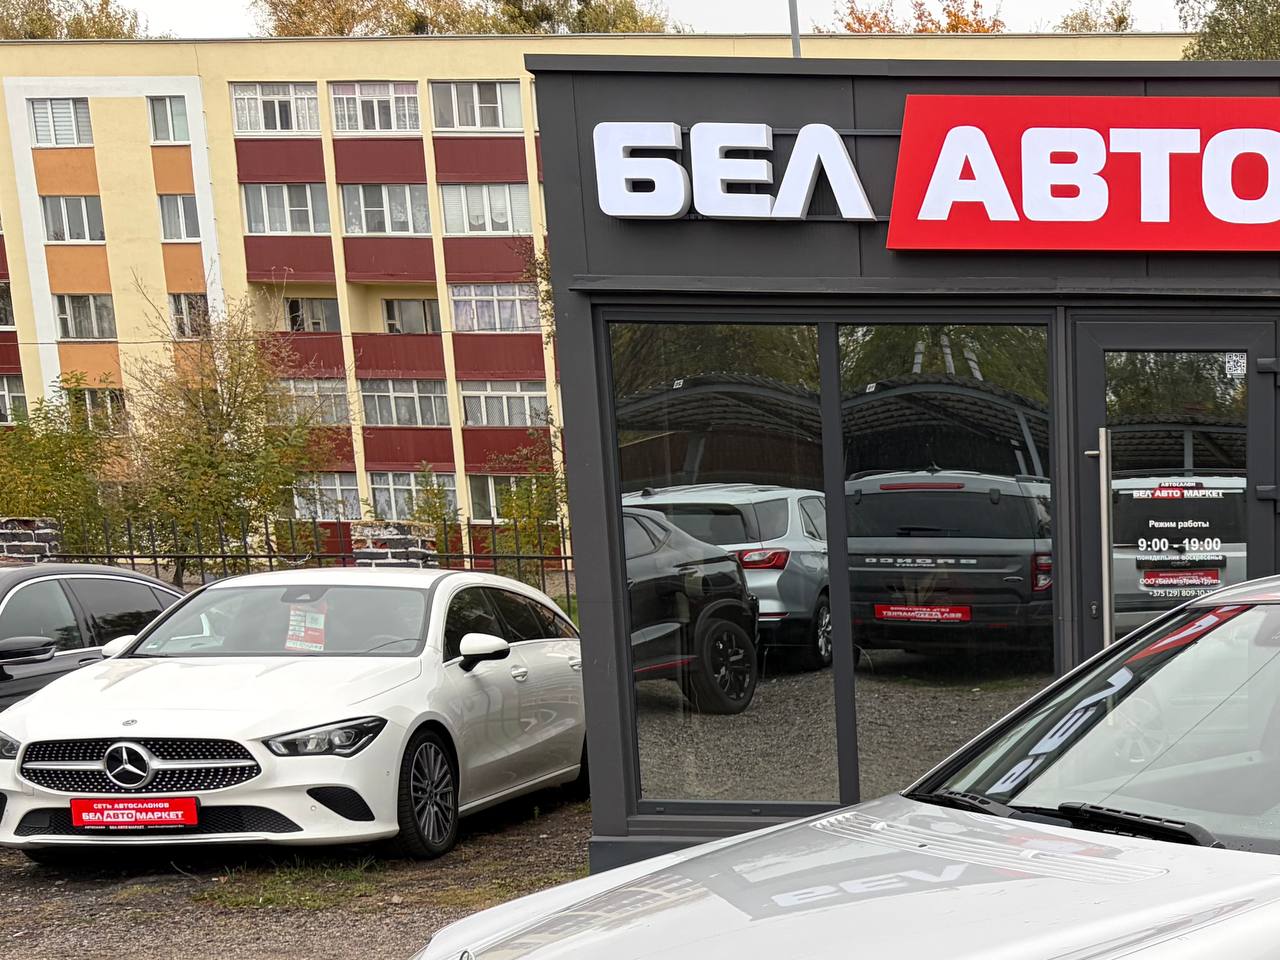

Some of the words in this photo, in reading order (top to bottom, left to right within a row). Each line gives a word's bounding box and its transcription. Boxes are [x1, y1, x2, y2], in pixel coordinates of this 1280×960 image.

[593, 122, 877, 221] БЕЛ
[1133, 490, 1152, 498] БЕЛ
[1154, 490, 1181, 498] АВТО
[1183, 490, 1224, 498] МАРКЕТ
[1149, 520, 1176, 528] Режим
[1178, 520, 1210, 530] работы
[1138, 538, 1169, 551] 9:00
[1183, 538, 1221, 551] 19:00
[82, 812, 103, 820] БЕЛ
[105, 812, 134, 820] АВТО
[136, 811, 184, 820] МАРКЕТ
